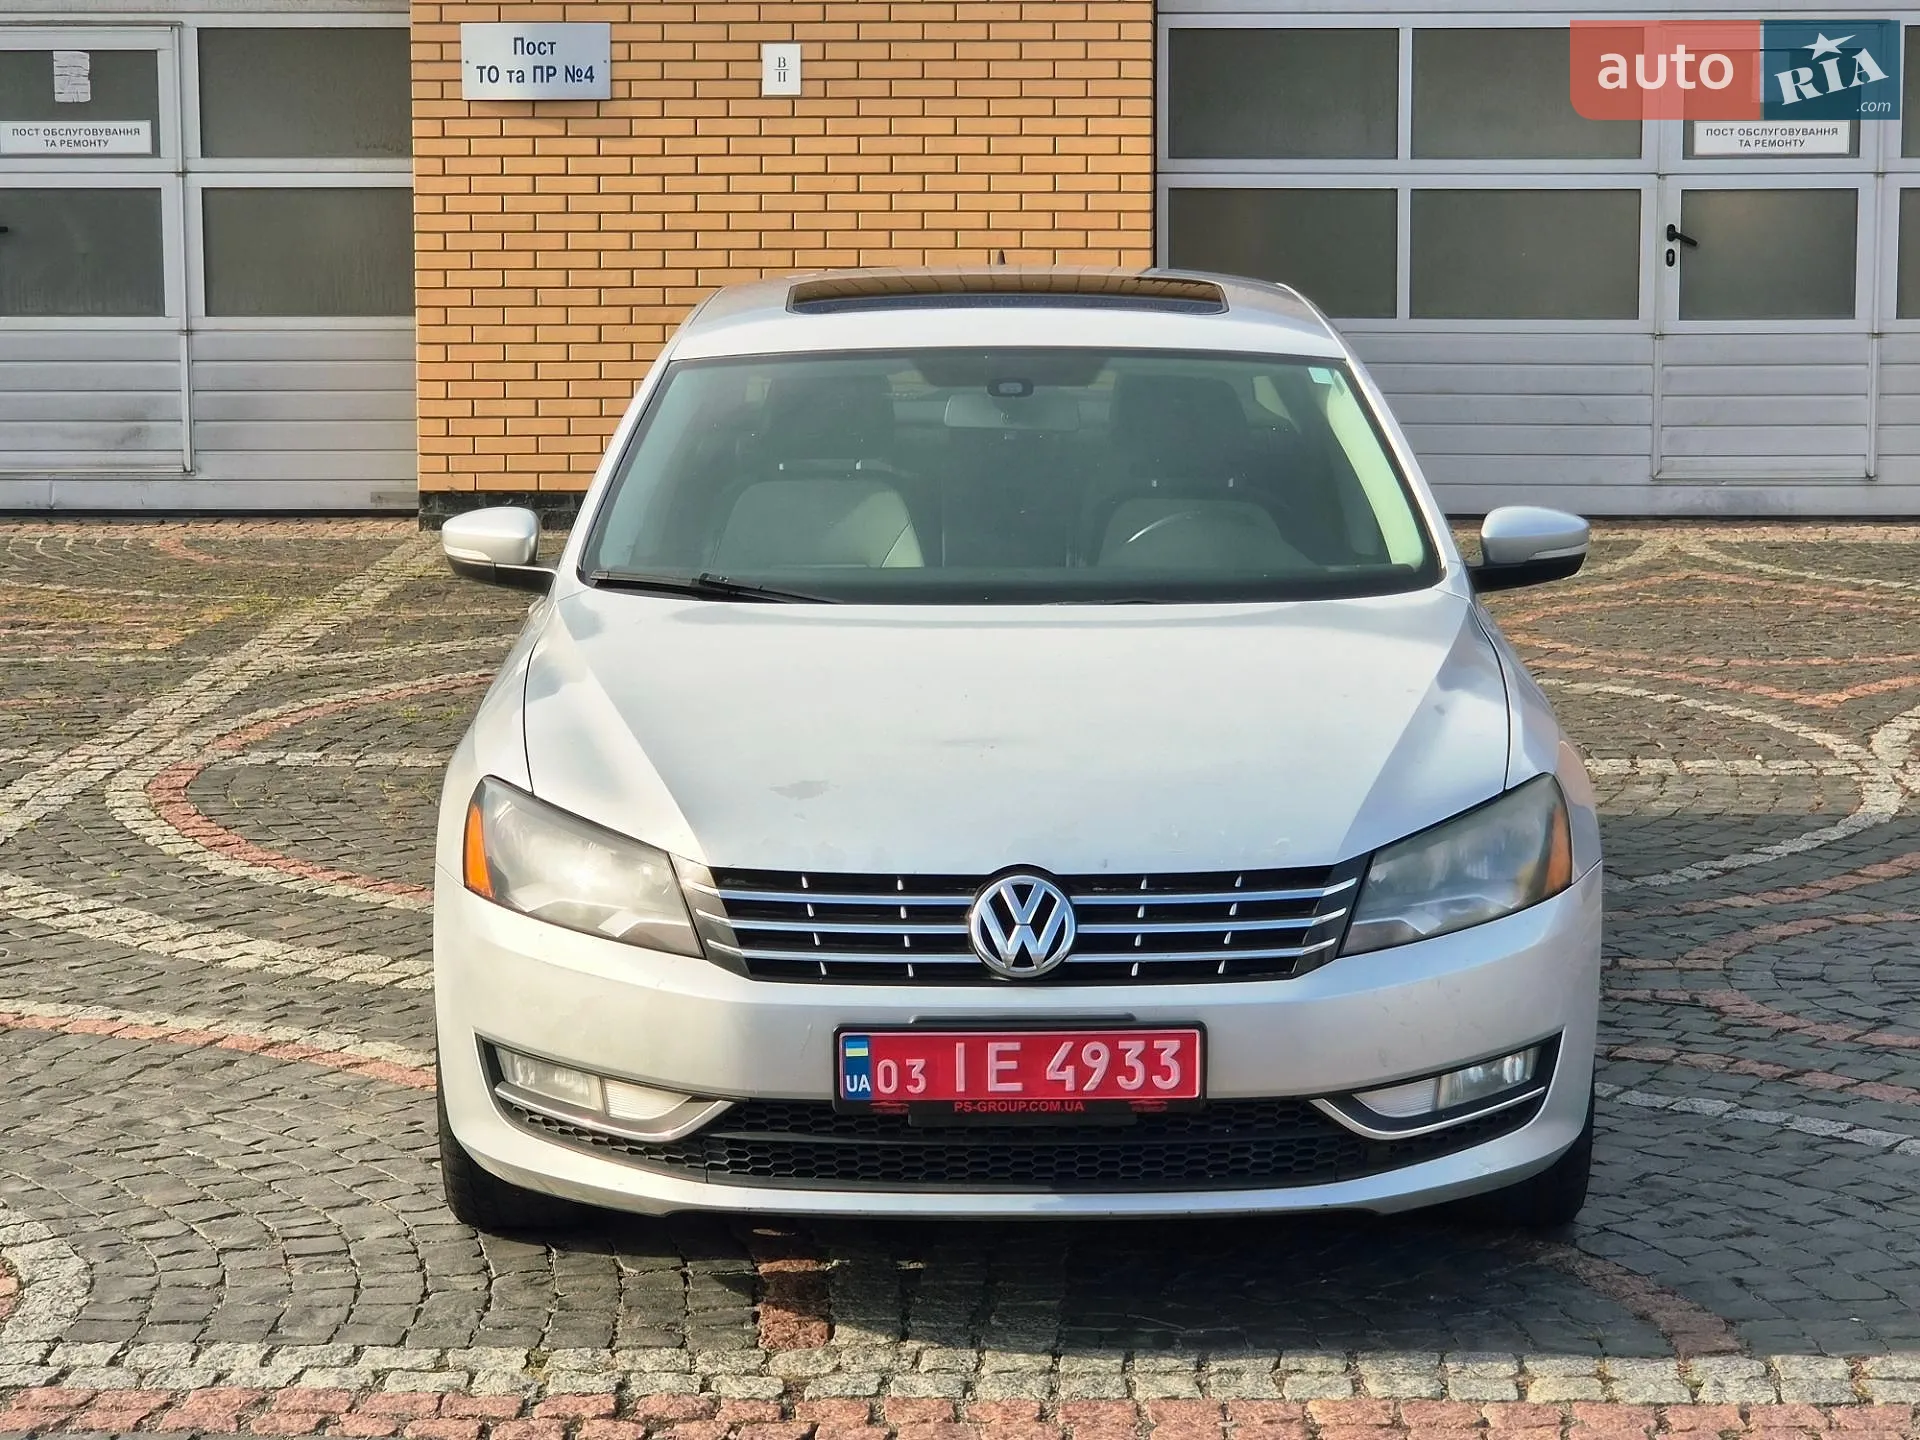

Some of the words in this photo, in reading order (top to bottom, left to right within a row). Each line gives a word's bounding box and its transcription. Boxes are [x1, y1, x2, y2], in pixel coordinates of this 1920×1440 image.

[513, 36, 557, 56] Пост
[476, 65, 500, 84] ТО
[506, 69, 525, 84] та
[532, 65, 558, 84] ПР
[564, 65, 595, 84] №4
[12, 127, 40, 137] ПОСТ
[42, 127, 141, 137] ОБСЛУГОВУВАННЯ
[1706, 127, 1735, 137] ПОСТ
[1737, 127, 1839, 137] ОБСЛУГОВУВАННЯ
[44, 139, 57, 148] ТА
[59, 139, 109, 148] РЕМОНТУ
[1738, 139, 1751, 148] ТА
[1754, 139, 1806, 148] РЕМОНТУ
[846, 1074, 871, 1092] UA
[877, 1058, 927, 1094] 03
[1046, 1040, 1181, 1092] 4933
[953, 1101, 1085, 1113] PS-GROUP.COM.UA
